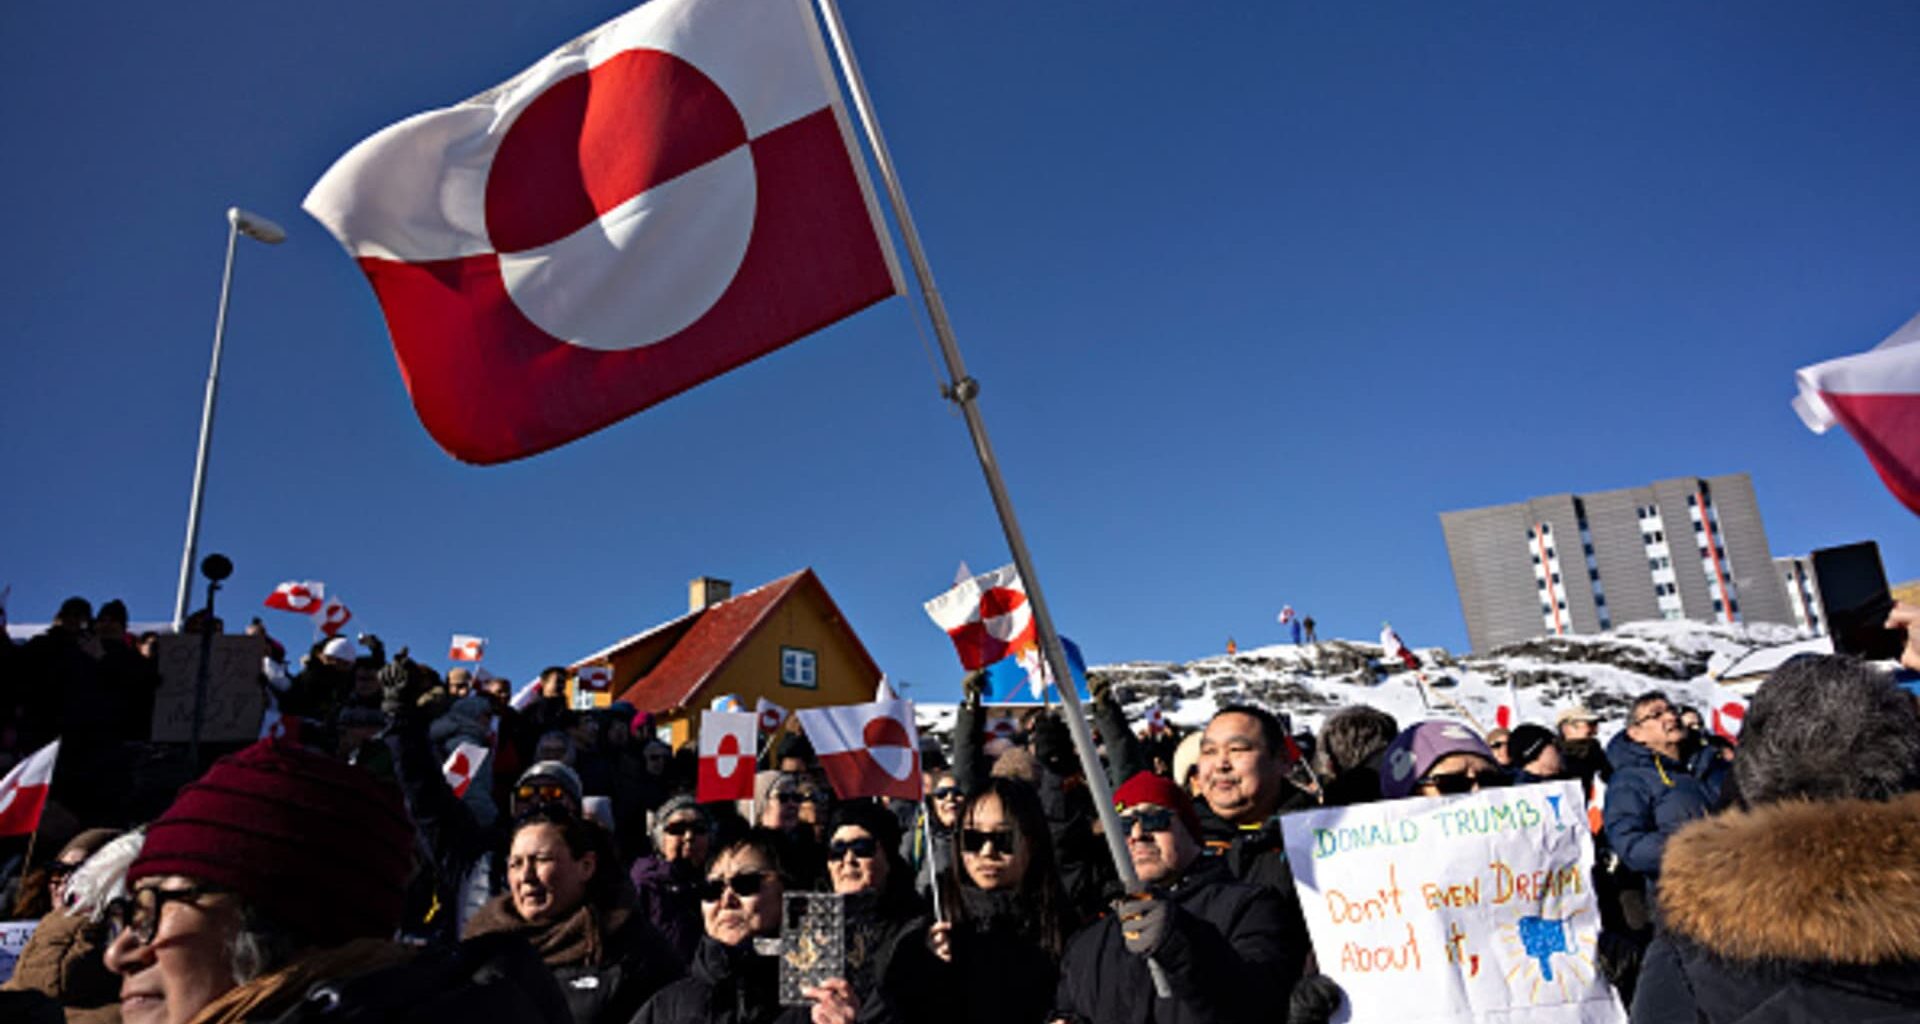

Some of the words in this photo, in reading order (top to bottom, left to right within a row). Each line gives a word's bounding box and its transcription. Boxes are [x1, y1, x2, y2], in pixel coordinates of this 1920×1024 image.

[1313, 818, 1418, 858] DONALD
[1326, 863, 1403, 924] Don't
[1422, 877, 1479, 910] EVEN
